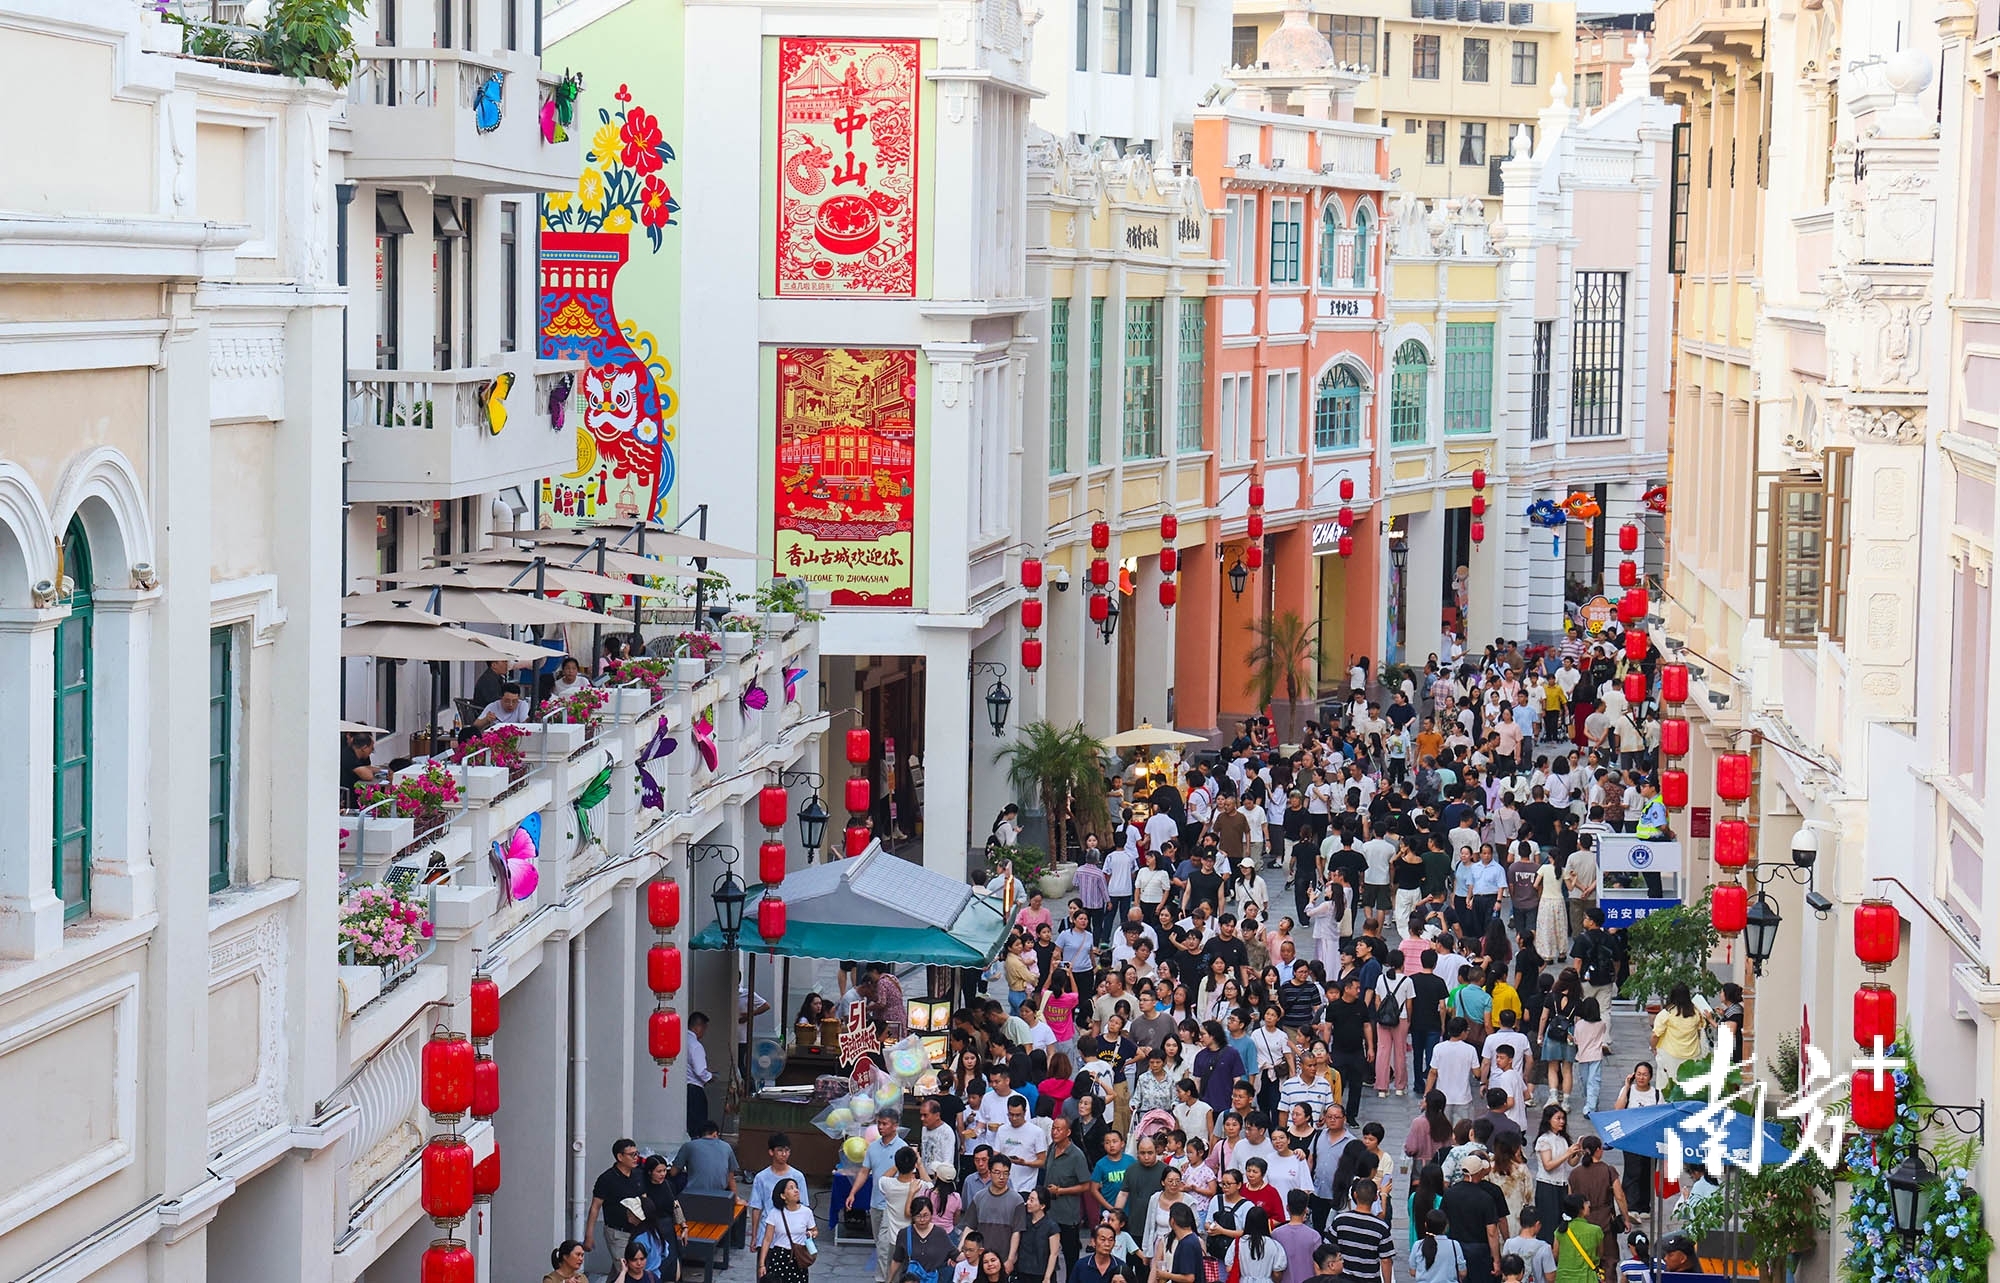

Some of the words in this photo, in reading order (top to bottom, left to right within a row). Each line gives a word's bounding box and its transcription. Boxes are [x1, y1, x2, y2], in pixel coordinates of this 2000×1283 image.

[832, 105, 868, 187] 中山
[785, 542, 904, 569] 香山古城欢迎你
[836, 574, 845, 583] TO
[846, 574, 889, 583] ZHONGSHAN
